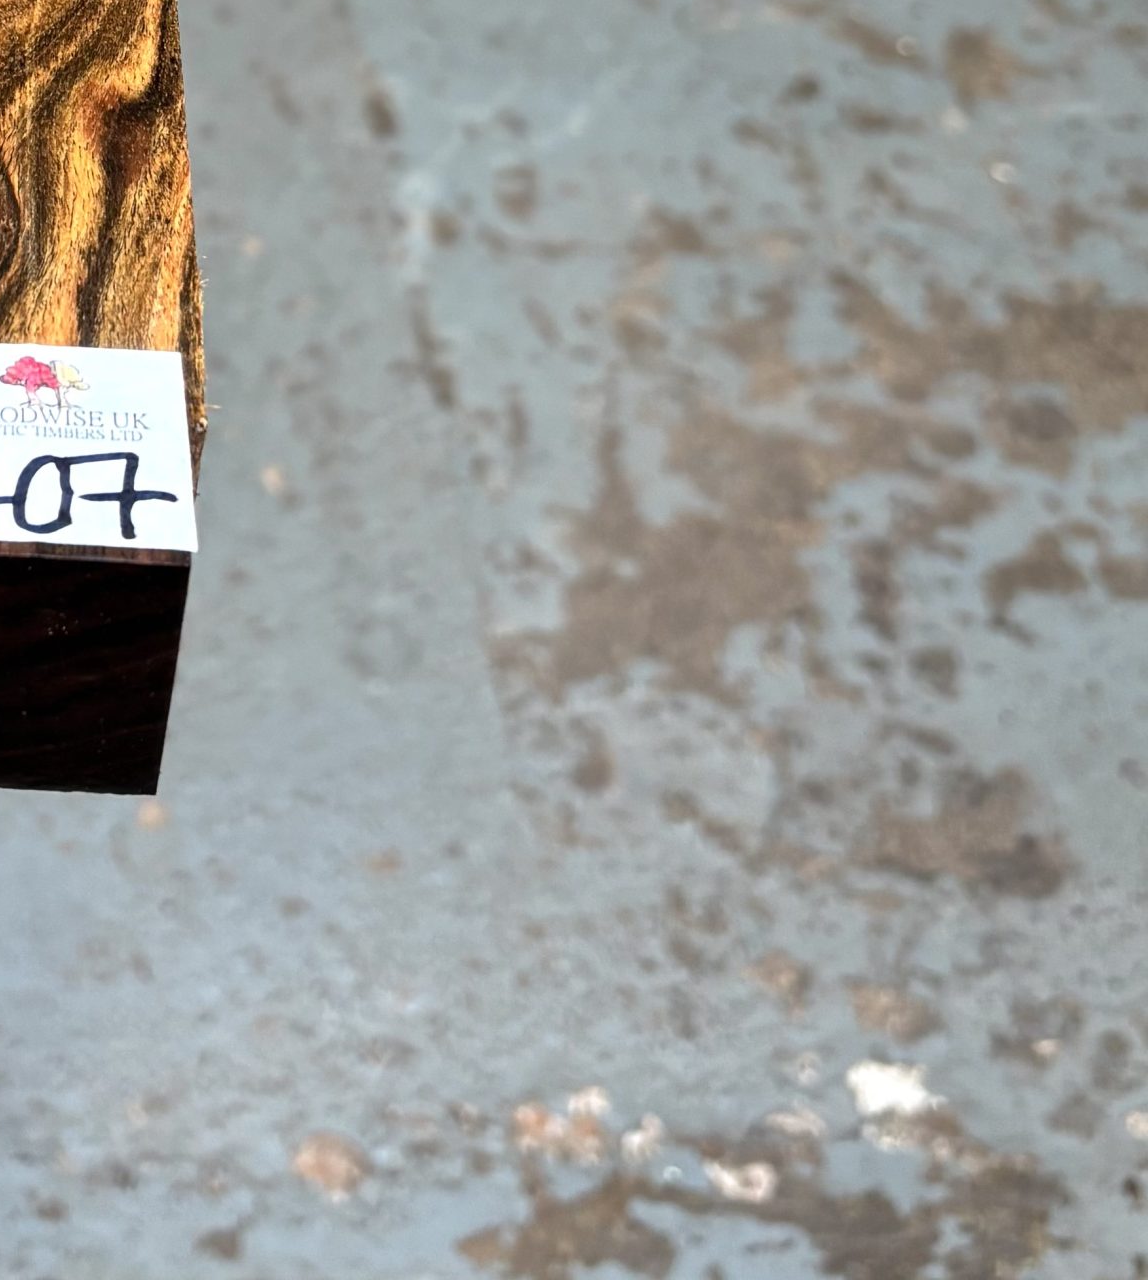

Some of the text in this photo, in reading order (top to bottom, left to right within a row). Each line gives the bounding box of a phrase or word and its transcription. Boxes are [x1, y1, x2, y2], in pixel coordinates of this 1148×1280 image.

[113, 411, 151, 430] UK
[31, 425, 105, 440] TIMBERS
[110, 429, 143, 442] LTD
